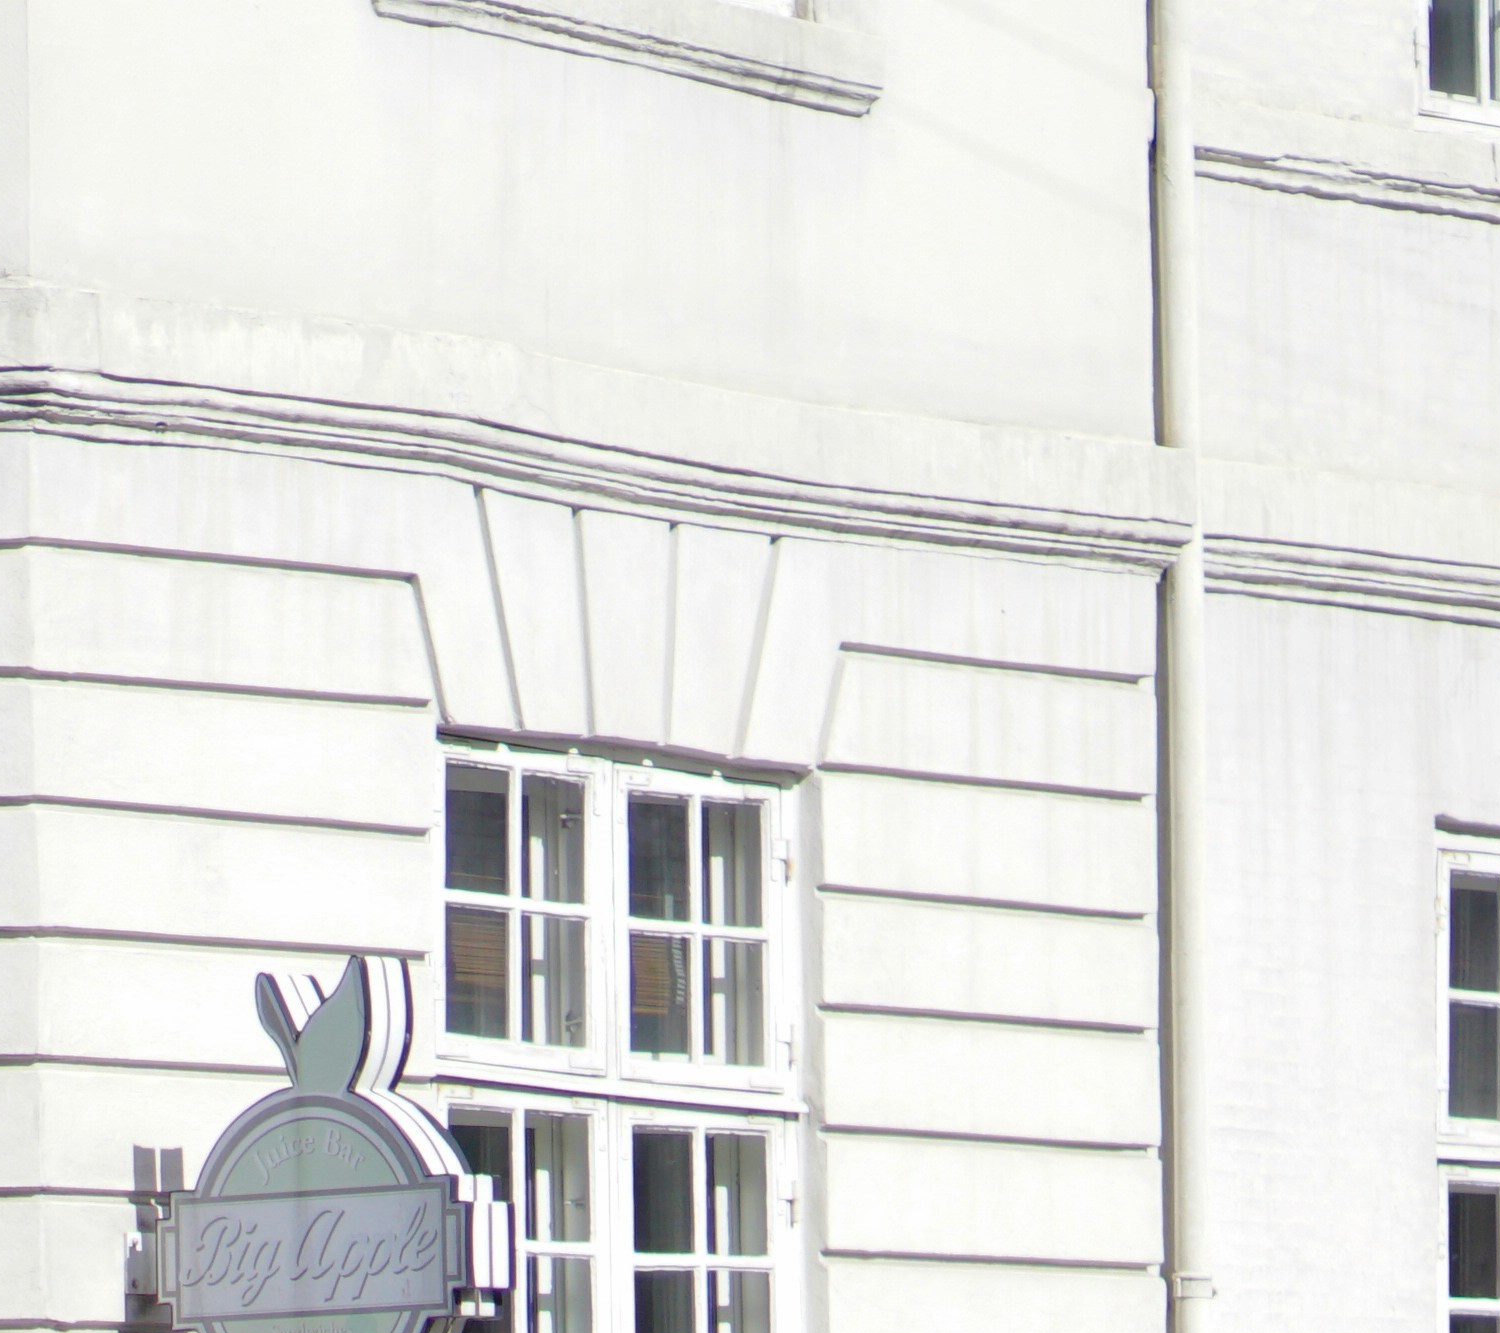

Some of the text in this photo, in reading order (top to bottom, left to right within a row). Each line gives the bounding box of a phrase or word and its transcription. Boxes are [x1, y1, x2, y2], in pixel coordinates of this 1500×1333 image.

[253, 1128, 366, 1186] Juice Bar
[180, 1202, 438, 1307] Big Apple
